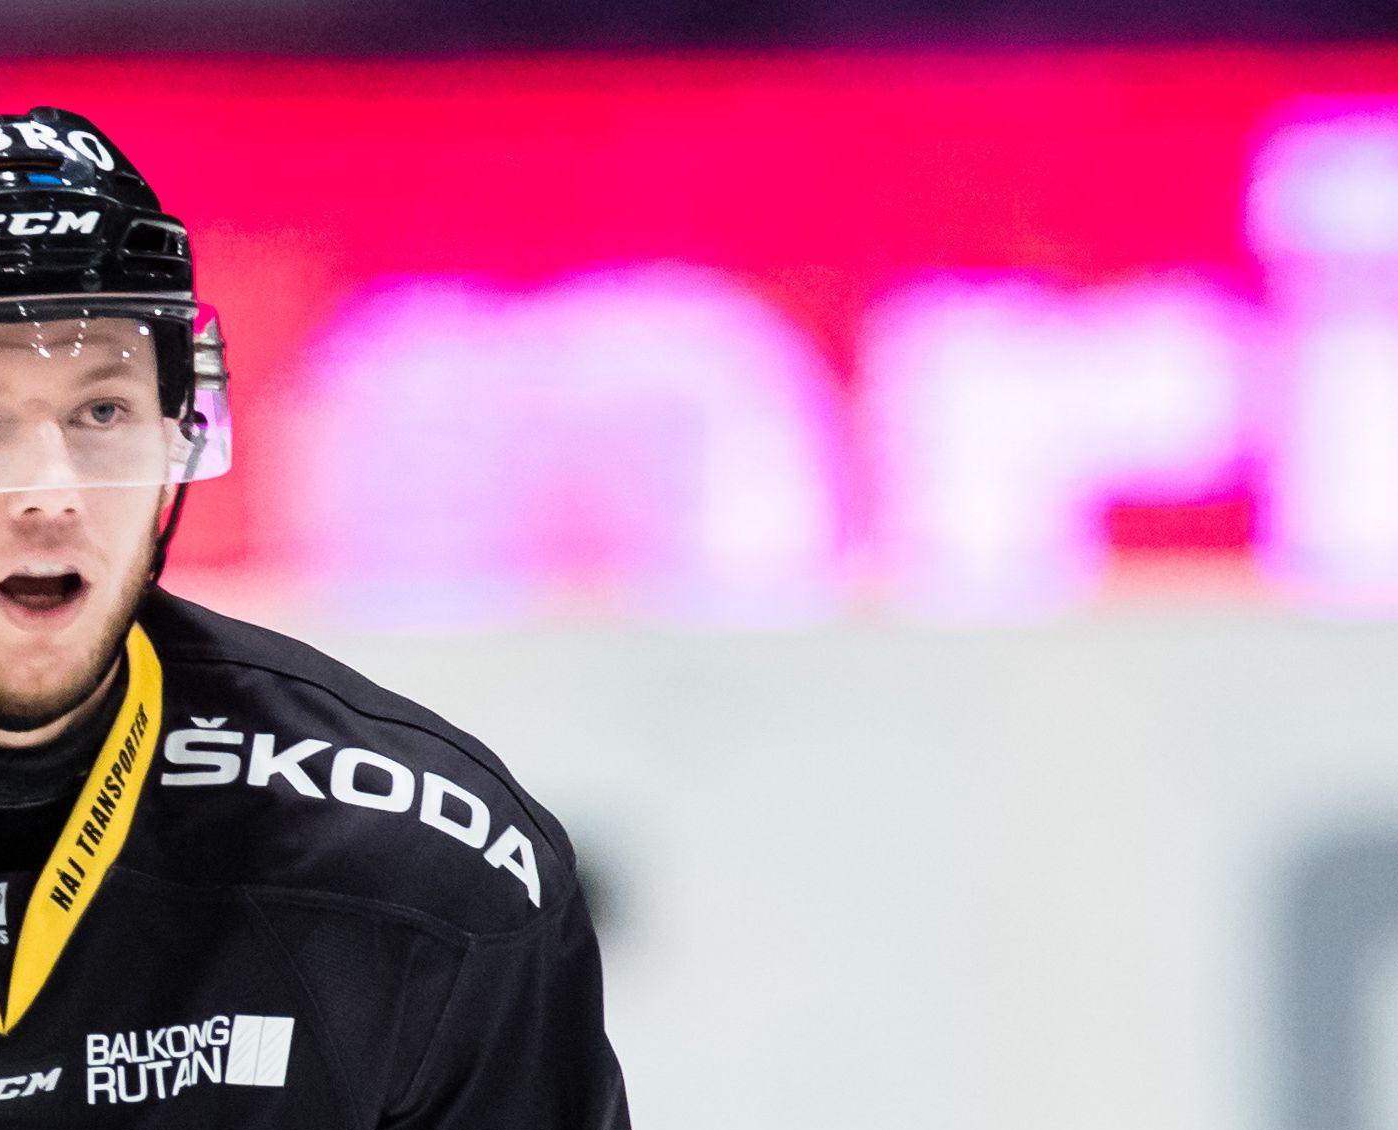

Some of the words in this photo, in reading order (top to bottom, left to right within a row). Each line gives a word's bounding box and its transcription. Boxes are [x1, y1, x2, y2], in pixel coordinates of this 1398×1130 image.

[50, 856, 86, 912] HÅJ
[75, 701, 148, 857] TRANSPORTER
[161, 717, 541, 908] ŠKODA
[86, 1016, 230, 1064] BALKONG
[87, 1049, 222, 1105] RUTAN
